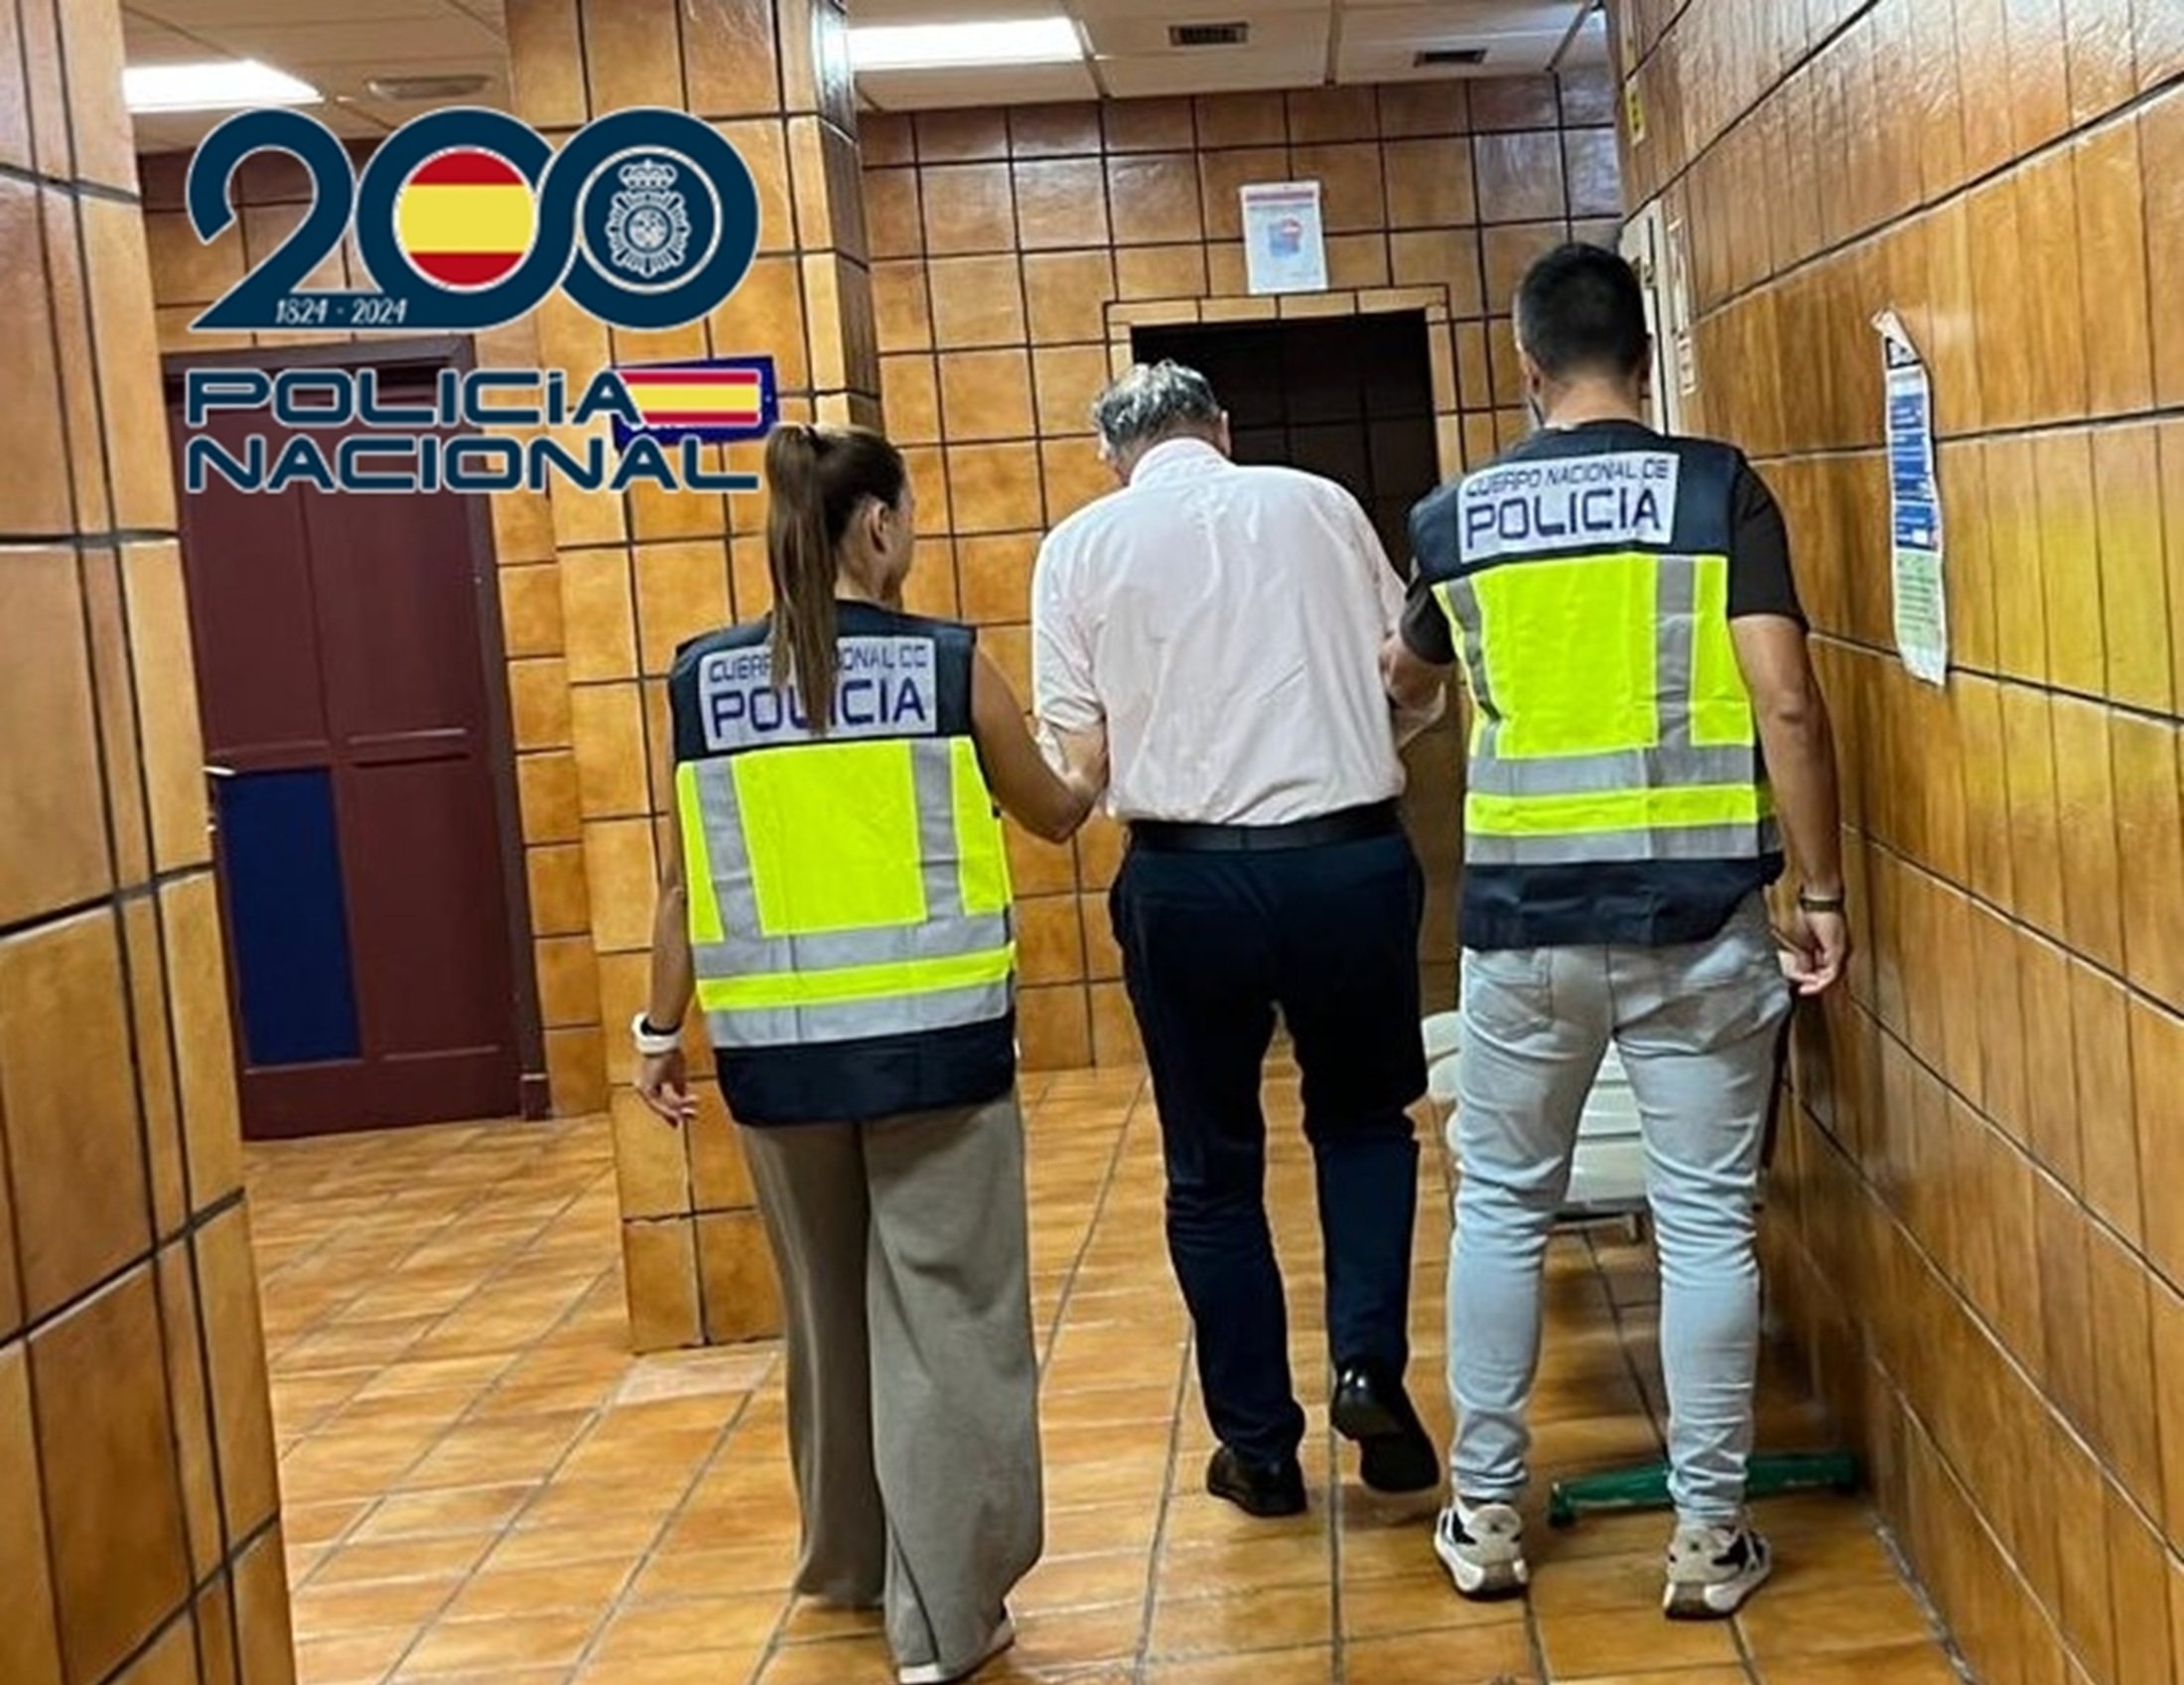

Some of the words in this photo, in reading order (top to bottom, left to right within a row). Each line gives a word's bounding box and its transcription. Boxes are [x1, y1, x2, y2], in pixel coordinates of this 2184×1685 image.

[1465, 469, 1542, 497] CUERPO
[1546, 459, 1637, 487] NACIONAL
[1642, 458, 1670, 481] DE
[1466, 487, 1662, 549] POLICIA
